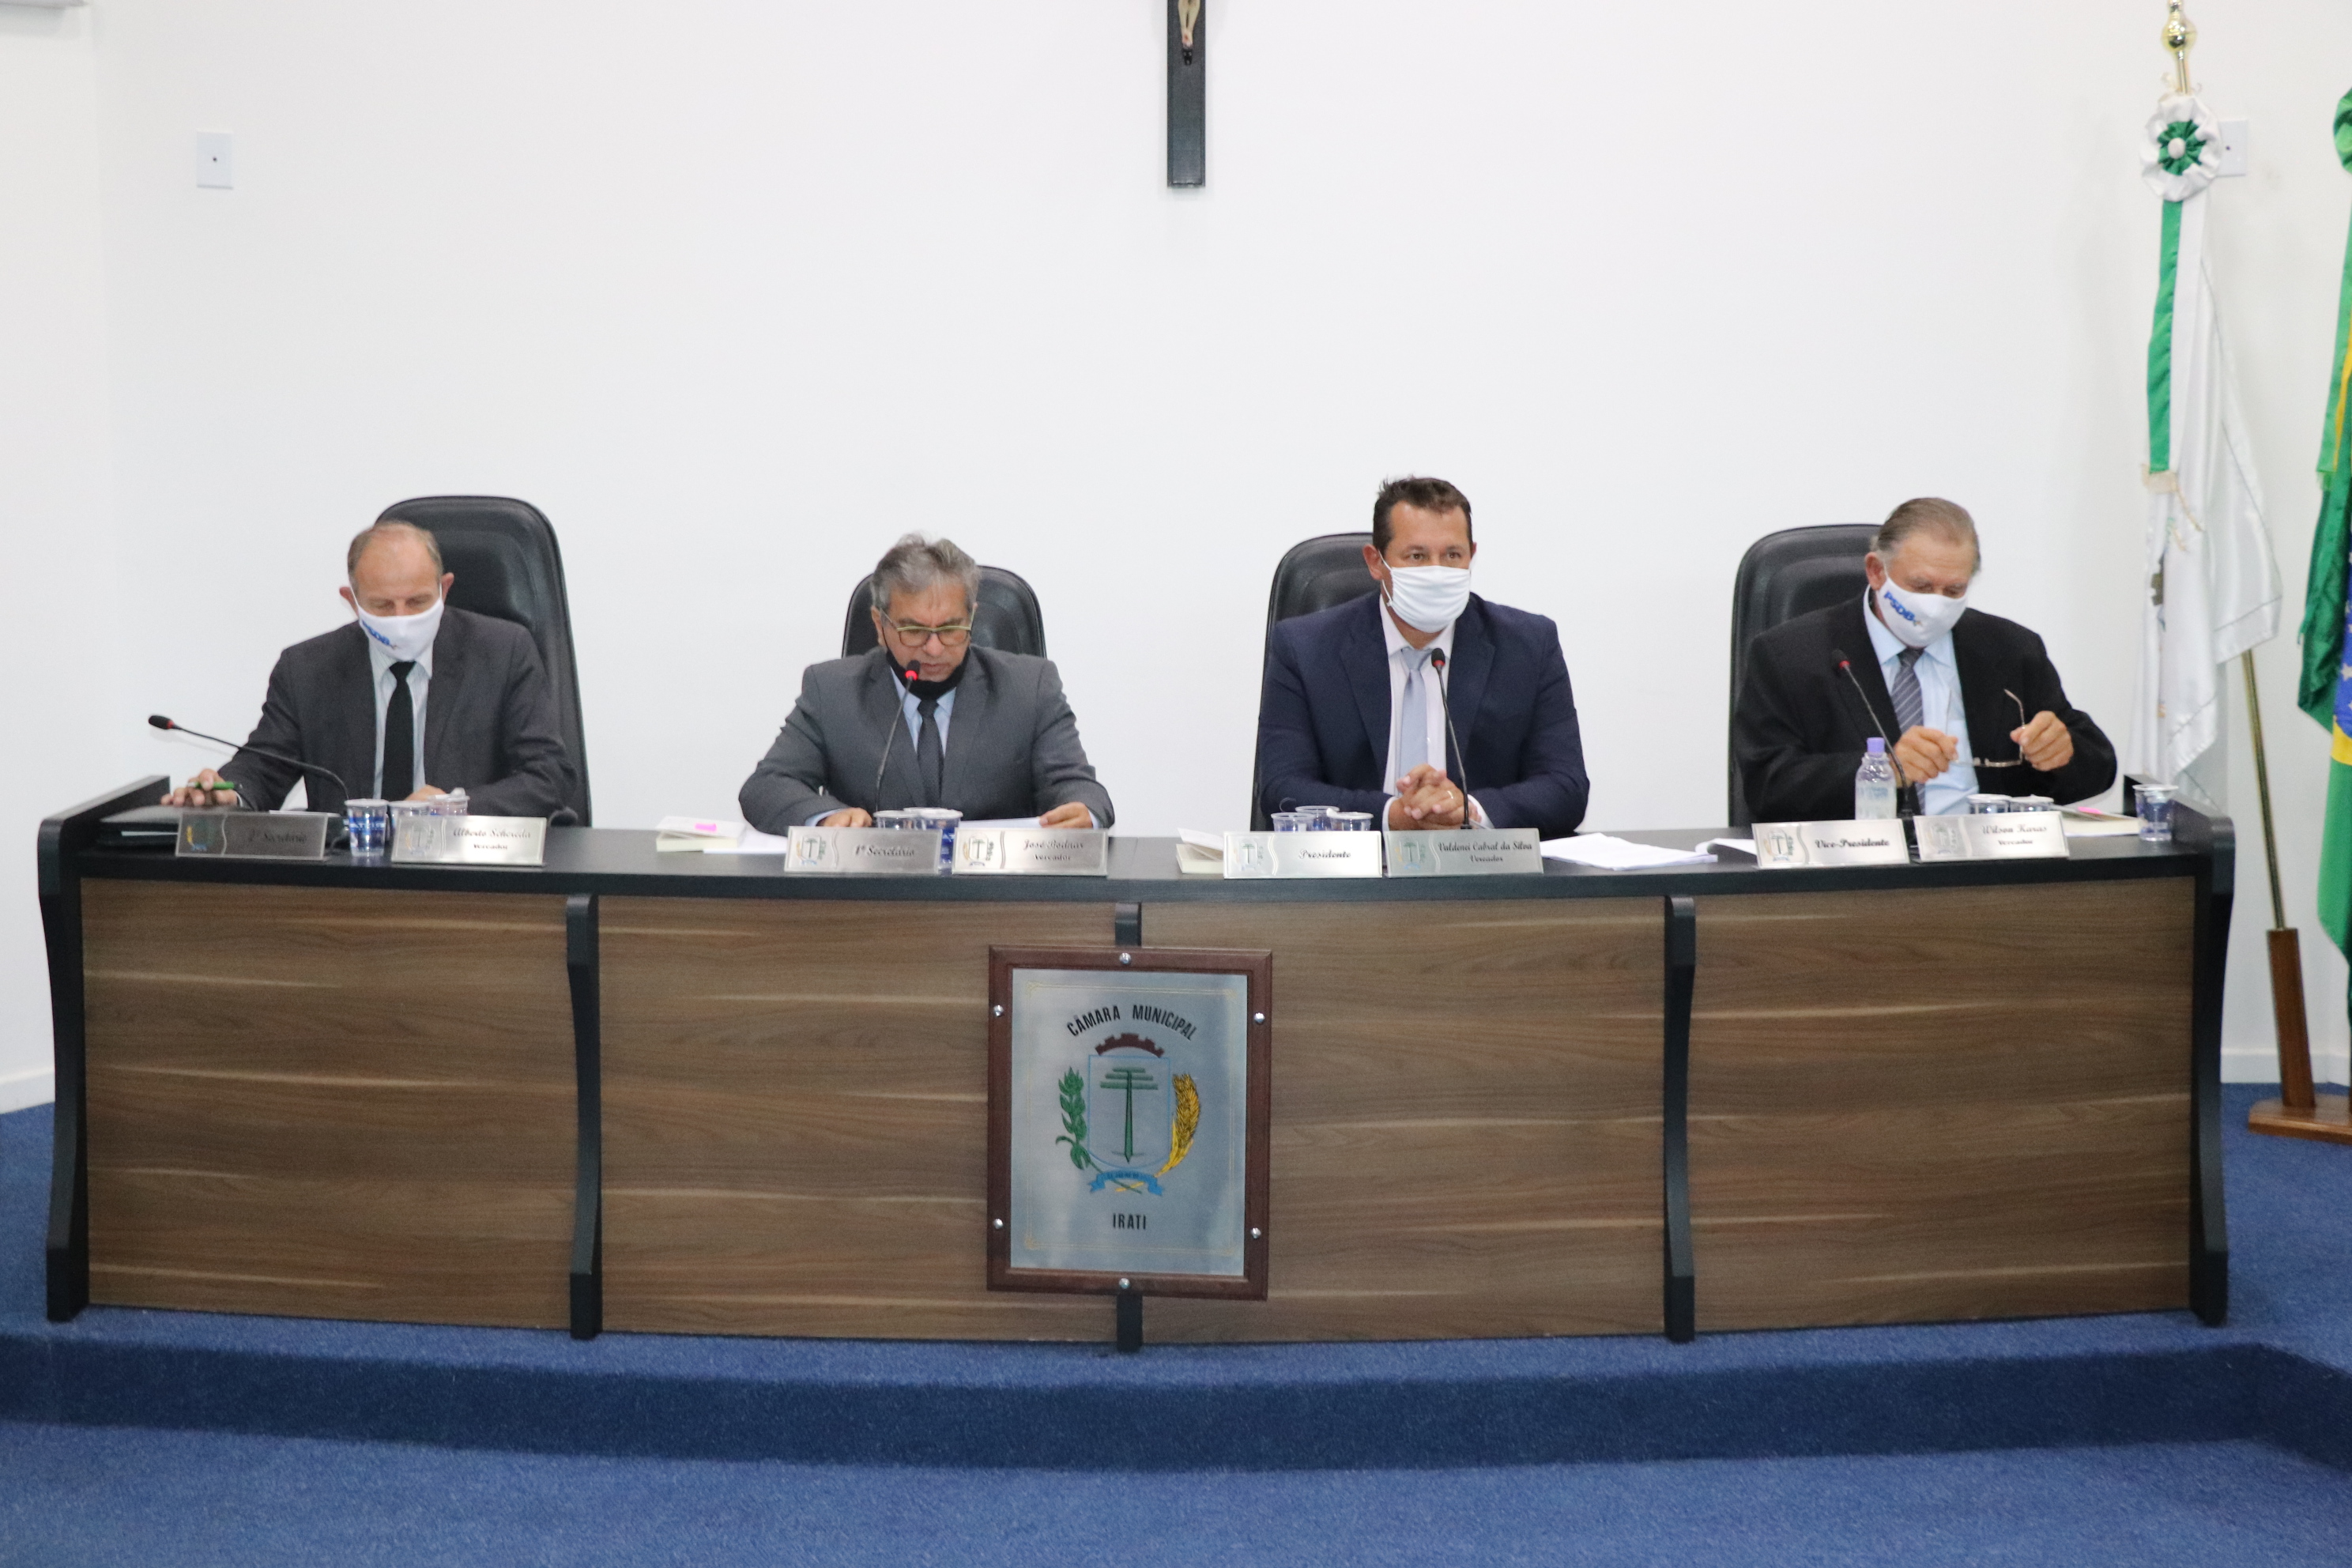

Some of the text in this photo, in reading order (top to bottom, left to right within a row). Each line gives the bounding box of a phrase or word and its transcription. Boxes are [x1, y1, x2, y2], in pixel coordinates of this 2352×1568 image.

[1884, 590, 1915, 621] PSDB
[453, 827, 487, 838] Alberto
[1982, 824, 2047, 835] Wilson Karas
[1023, 839, 1042, 850] José
[1438, 841, 1532, 852] Valdenei Cabral da Silva
[1815, 838, 1890, 849] Vice-Presidente
[1034, 853, 1071, 861] Vereador
[1298, 848, 1351, 860] Presidente
[1067, 1004, 1197, 1042] CÂMARA MUNICIPAL
[1113, 1212, 1146, 1230] IRATI
